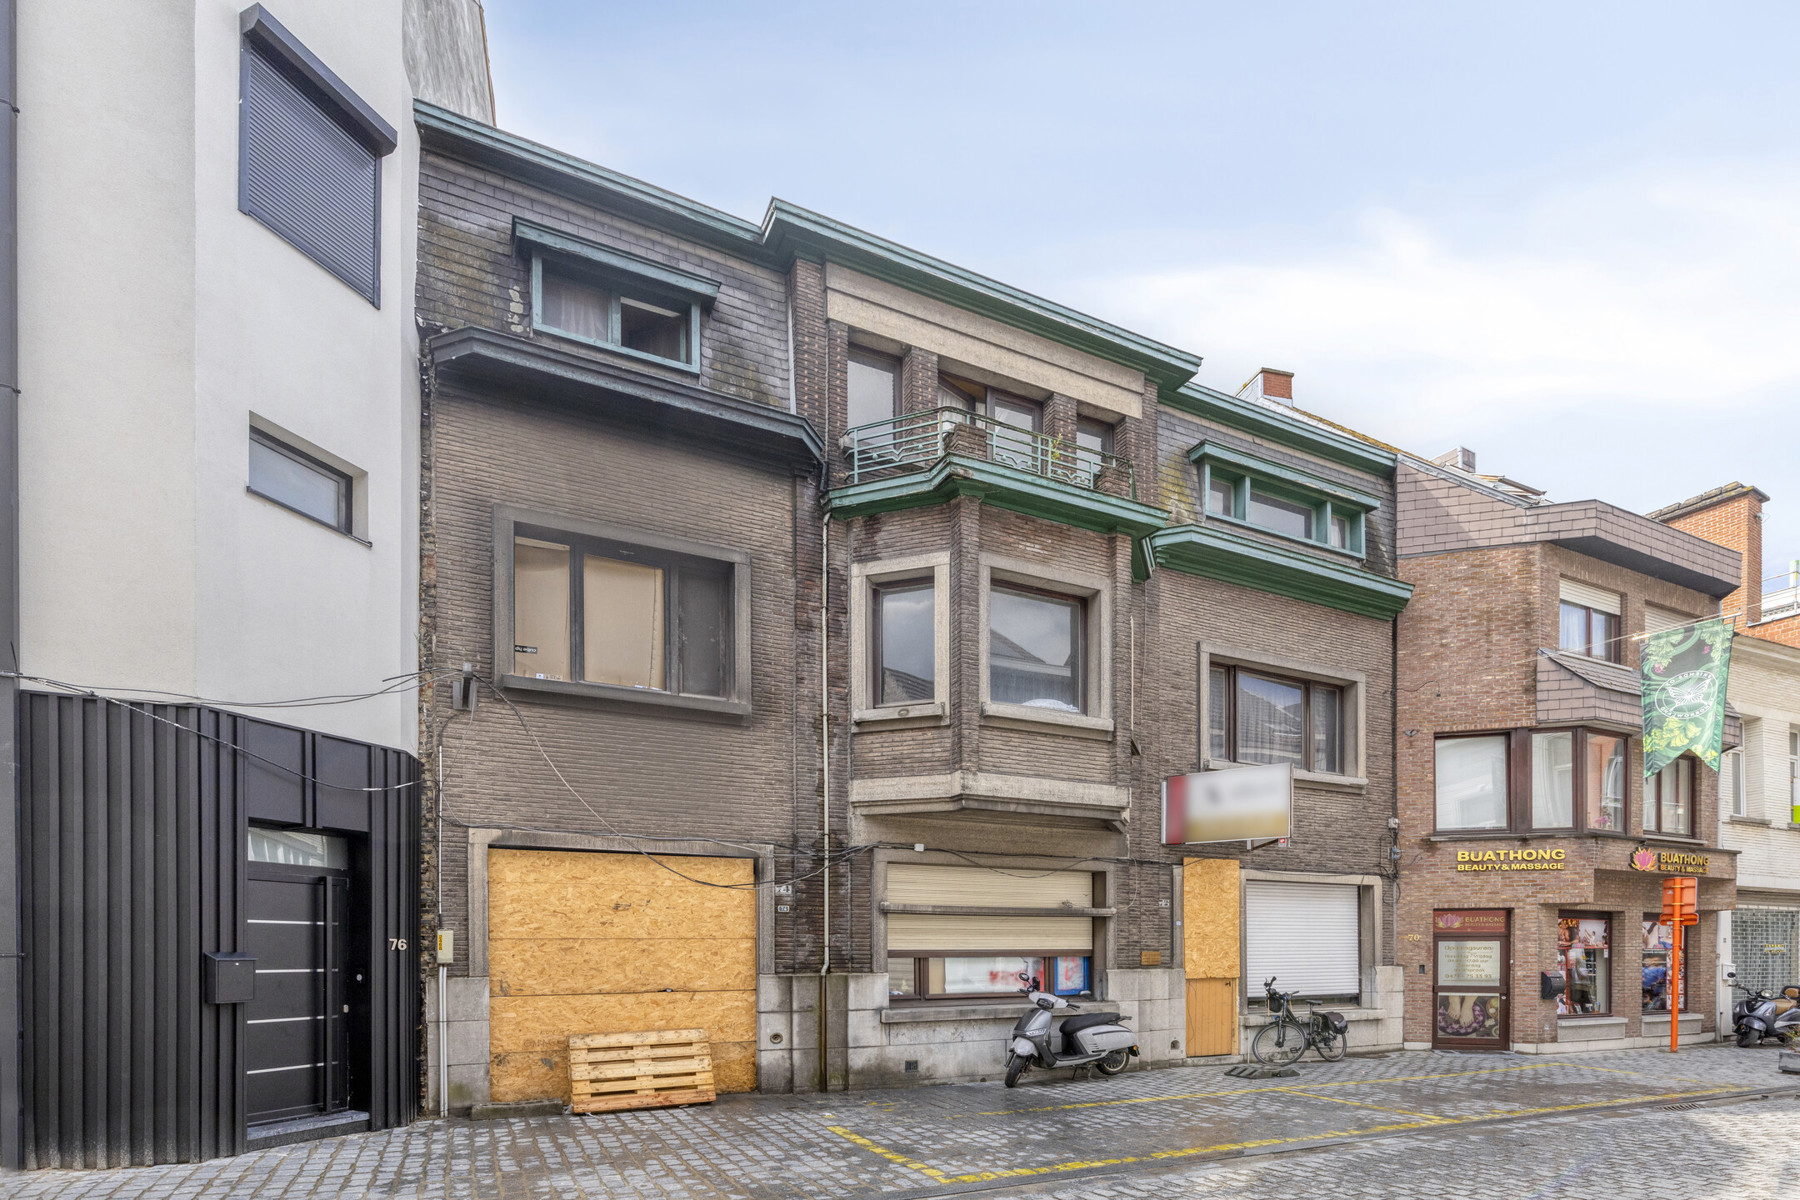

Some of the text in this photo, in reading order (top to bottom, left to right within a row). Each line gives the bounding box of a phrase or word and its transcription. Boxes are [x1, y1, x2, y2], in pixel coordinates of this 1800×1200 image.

[1457, 849, 1566, 862] BUATHONG
[1660, 852, 1710, 866] BUATHONG
[388, 938, 407, 951] 76
[1408, 934, 1420, 942] 70
